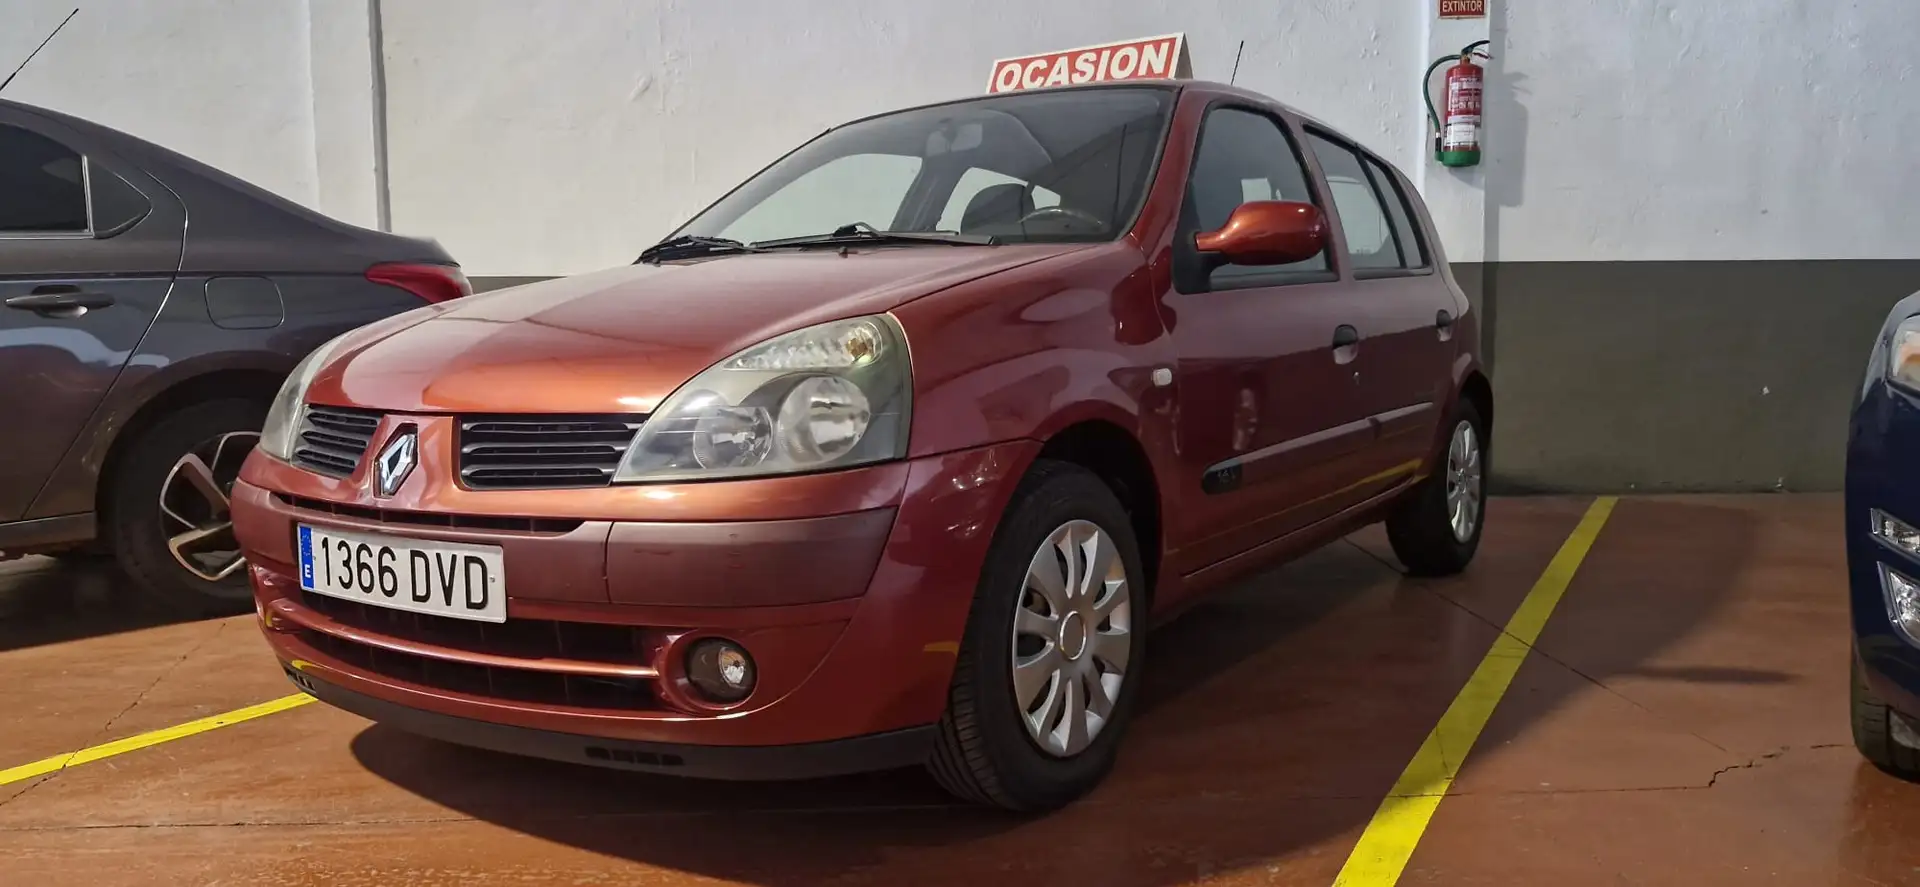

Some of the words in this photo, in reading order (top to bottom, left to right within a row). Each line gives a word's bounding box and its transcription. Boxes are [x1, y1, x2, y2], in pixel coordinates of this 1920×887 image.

[1442, 0, 1482, 13] EXTINTOR
[996, 42, 1169, 93] OCASION
[304, 564, 312, 578] E
[321, 537, 398, 598] 1366
[410, 549, 488, 610] DVD
